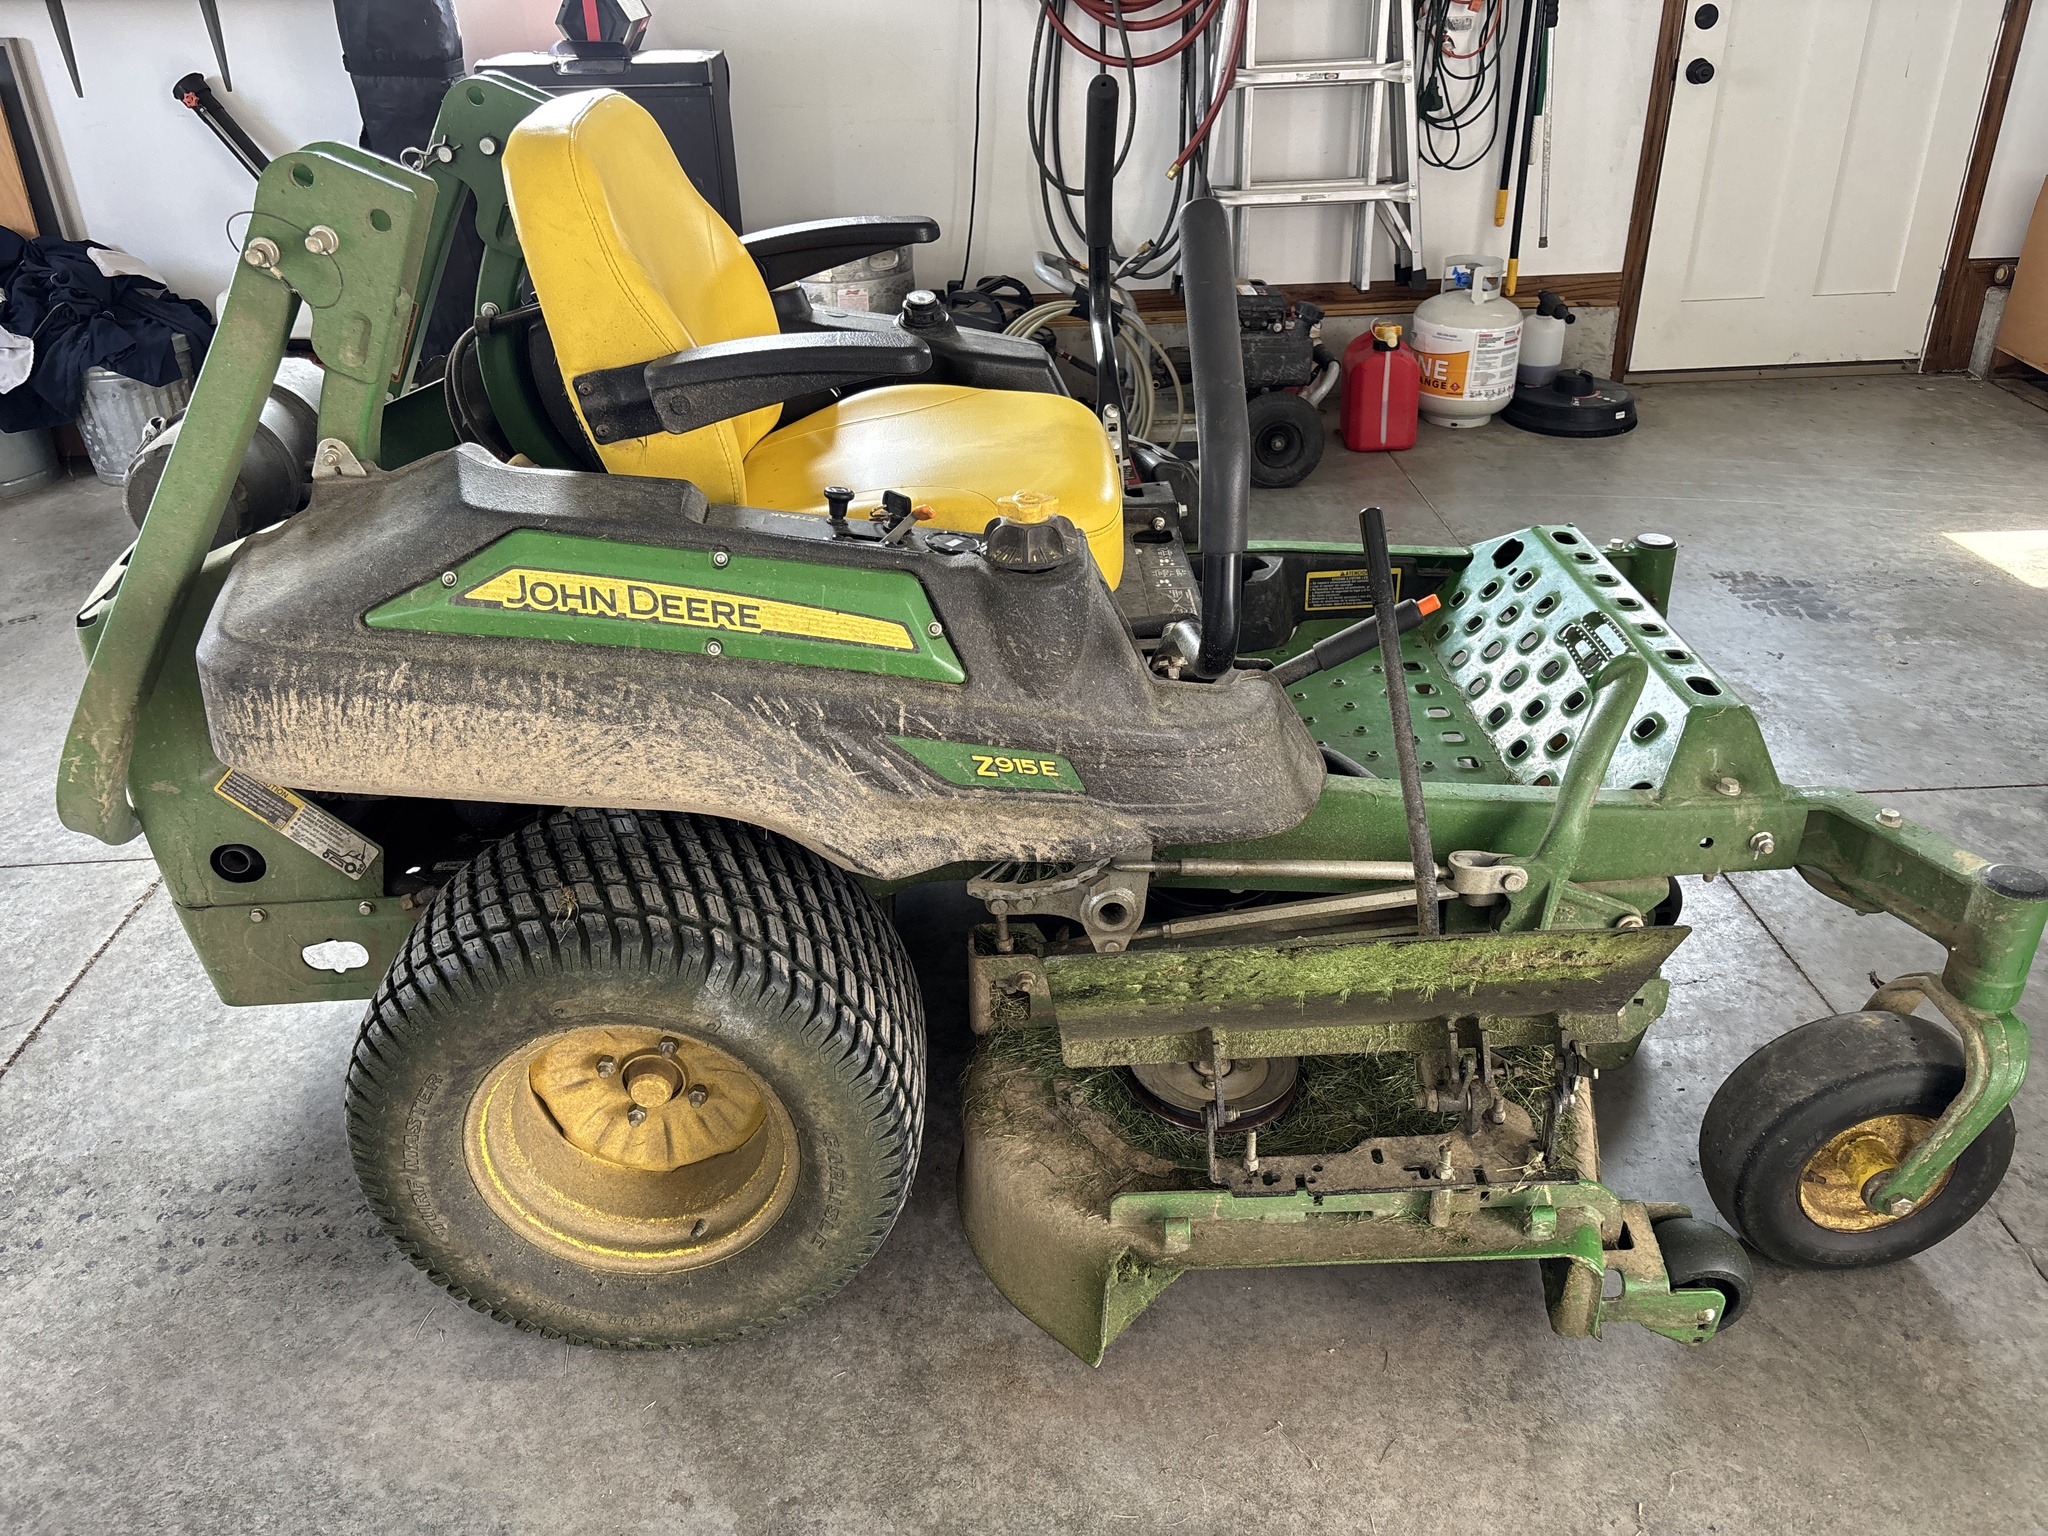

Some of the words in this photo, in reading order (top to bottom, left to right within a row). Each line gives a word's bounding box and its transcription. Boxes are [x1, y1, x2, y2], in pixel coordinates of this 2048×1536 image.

[506, 574, 617, 613] JOHN
[627, 584, 762, 629] DEERE
[971, 755, 1060, 778] Z915E
[403, 1072, 444, 1172] MASTER
[406, 1178, 446, 1236] TURF
[811, 1131, 845, 1250] CARLISLE
